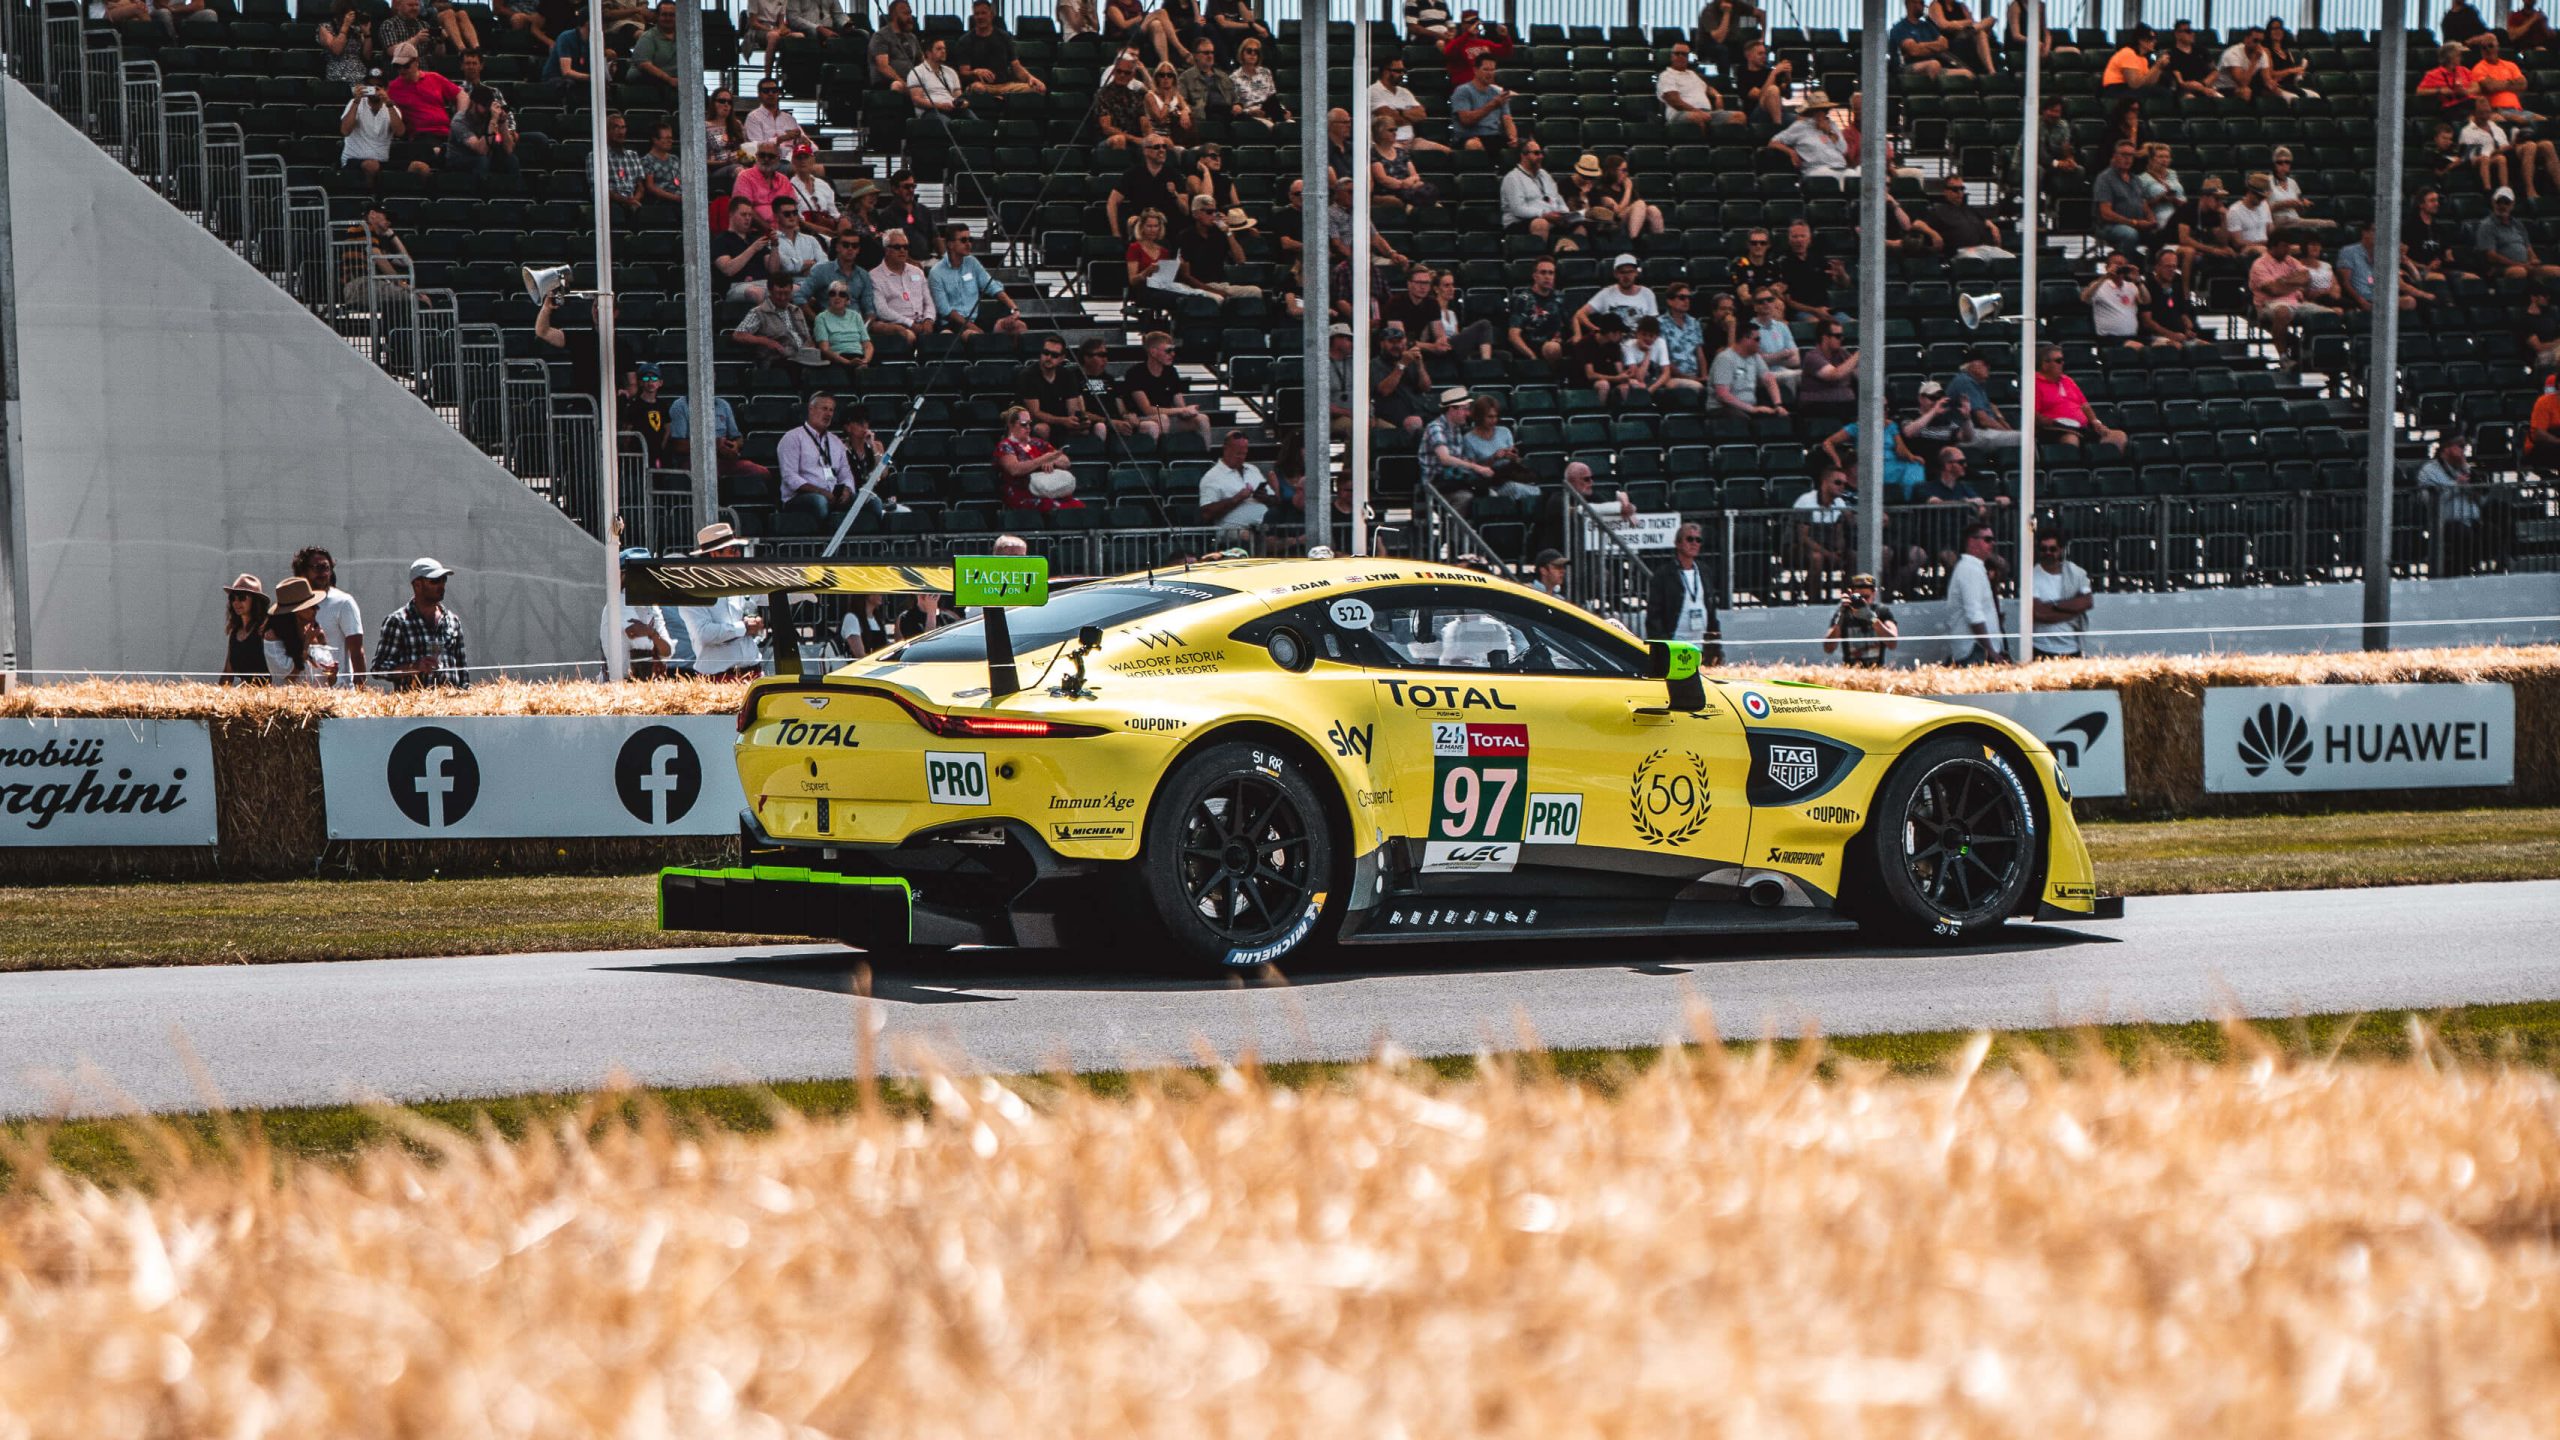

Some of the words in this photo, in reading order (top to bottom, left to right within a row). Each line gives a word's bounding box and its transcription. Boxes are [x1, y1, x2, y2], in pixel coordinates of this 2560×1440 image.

[1648, 518, 1676, 529] TICKET
[1641, 533, 1664, 544] ONLY
[646, 566, 755, 590] ASTON
[737, 566, 842, 588] MARTIN
[964, 568, 1040, 585] HACKETT
[1291, 579, 1332, 592] ADAM
[1364, 572, 1401, 582] LYNN
[1435, 572, 1488, 584] MARTIN
[983, 586, 1021, 595] LONON
[1337, 605, 1367, 622] 522
[1109, 655, 1171, 672] WALDORF
[1175, 650, 1225, 665] ASTORIA
[1126, 668, 1165, 679] HOTELS
[1166, 668, 1175, 676] &
[1176, 664, 1219, 675] RESORTS
[1377, 679, 1517, 711] TOTAL
[1768, 696, 1788, 706] Royal
[1798, 697, 1821, 705] Force
[1772, 704, 1812, 714] Benevolent
[1812, 704, 1833, 712] Fund
[776, 718, 860, 748] TOTAL
[1131, 718, 1181, 731] DUPONT
[1328, 719, 1374, 765] sky
[1436, 725, 1465, 744] 24h
[1470, 732, 1526, 748] TOTAL
[2326, 722, 2488, 764] HUAWEI
[1269, 755, 1283, 772] RR
[1774, 749, 1813, 764] TAG
[929, 760, 984, 797] PRO
[1771, 765, 1815, 787] HEUER
[1441, 766, 1518, 838] 97
[1647, 773, 1695, 817] 59
[2001, 762, 2034, 829] MICHELIN
[1529, 801, 1578, 837] PRO
[1813, 805, 1856, 824] DUPONT
[1072, 827, 1126, 835] MICHELIN
[1447, 845, 1508, 862] WEC
[1231, 920, 1309, 964] MICHELIN
